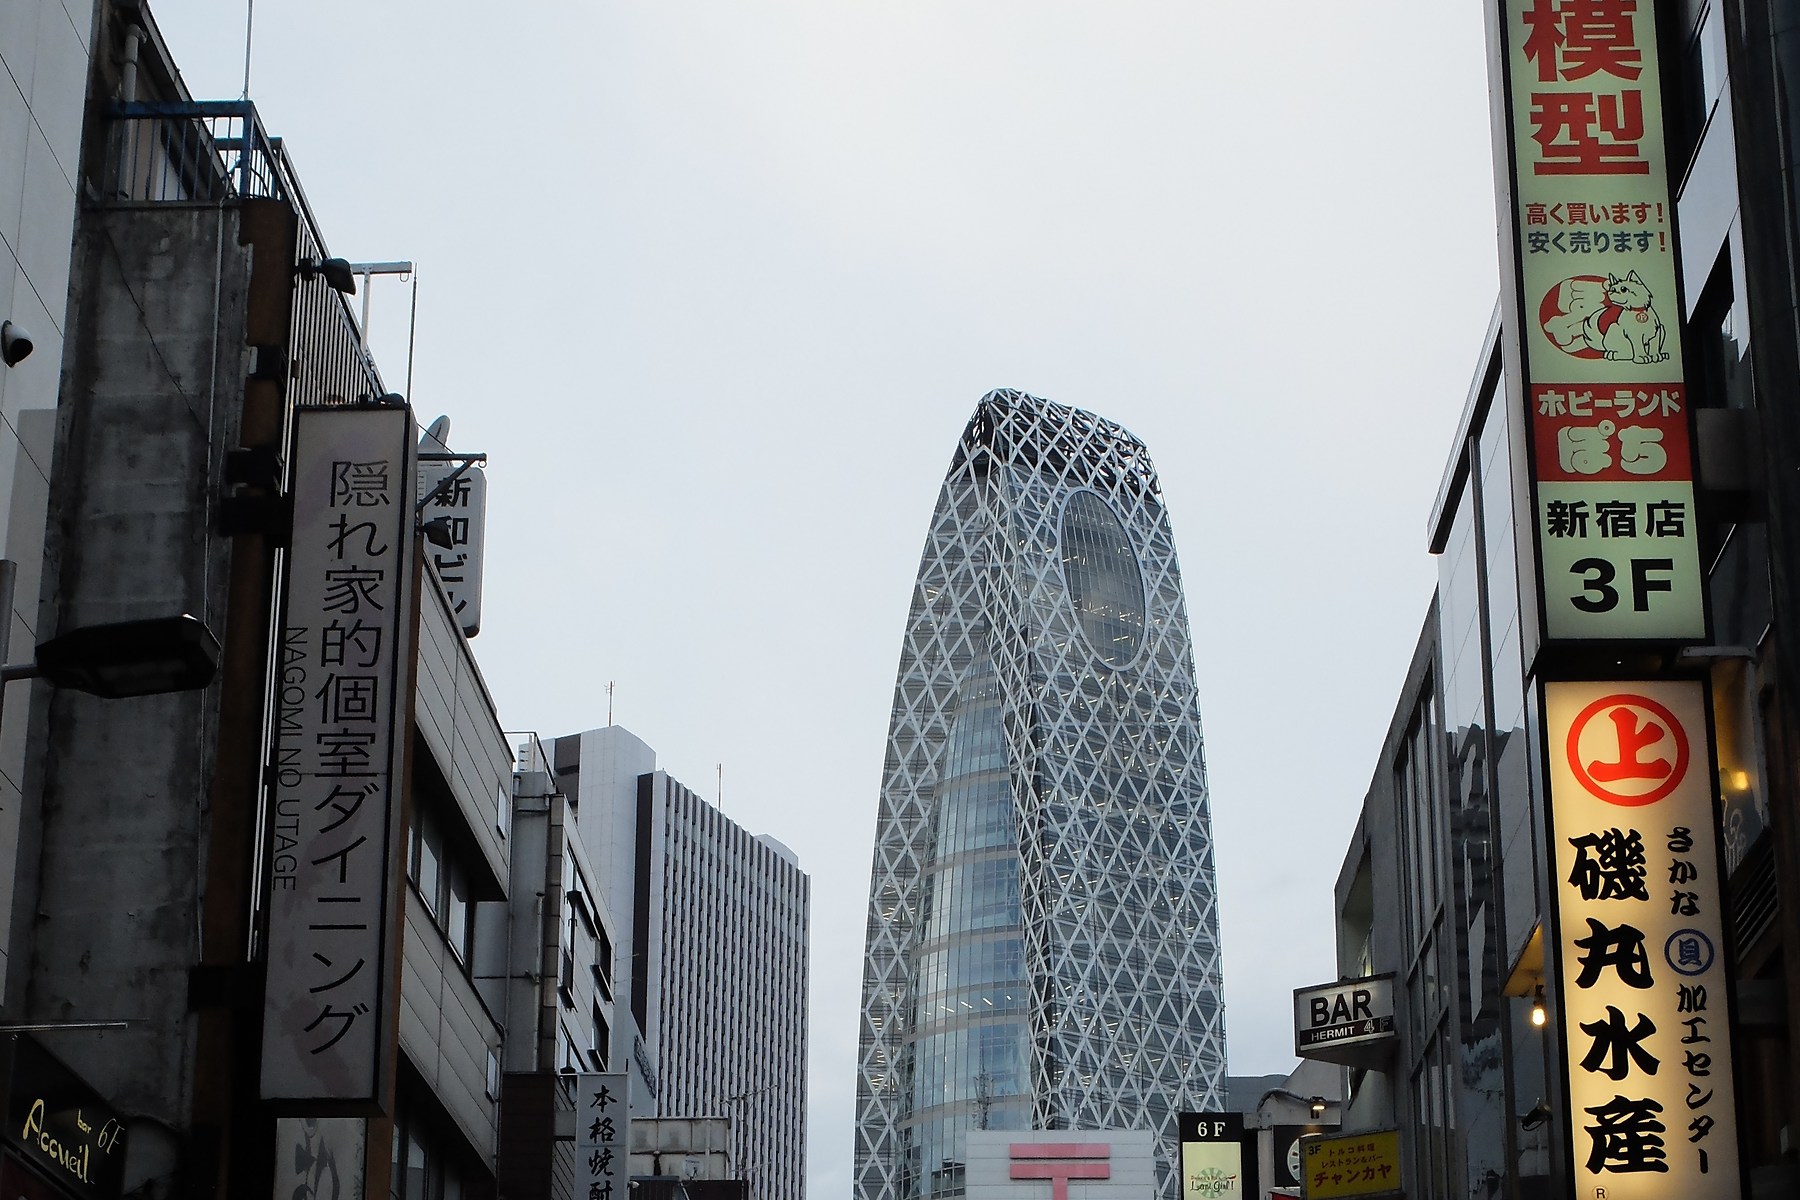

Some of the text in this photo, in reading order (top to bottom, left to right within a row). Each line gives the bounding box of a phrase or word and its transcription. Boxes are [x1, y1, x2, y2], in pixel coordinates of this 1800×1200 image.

[1521, 0, 1651, 176] 模型
[1525, 201, 1664, 227] 高く買います!
[1527, 230, 1667, 255] 安く売ります!
[1537, 388, 1682, 420] ホビーランド
[1556, 419, 1668, 475] ぽち
[1546, 499, 1686, 539] 新宿店
[1569, 557, 1675, 613] 3F
[273, 627, 308, 892] NAGOMI NO UTAGE
[303, 459, 390, 1055] 隠れ家的個室ダイニング
[1586, 706, 1673, 783] 上
[1310, 989, 1374, 1028] BAR
[1567, 826, 1670, 1176] 磯丸水産
[1311, 1025, 1355, 1042] HERMIT
[21, 1098, 89, 1184] Accueil
[75, 1107, 126, 1155] bar 6F
[1308, 1144, 1322, 1156] 3F
[1328, 1143, 1376, 1157] トルコ料理
[1313, 1163, 1393, 1188] チャンカヤ
